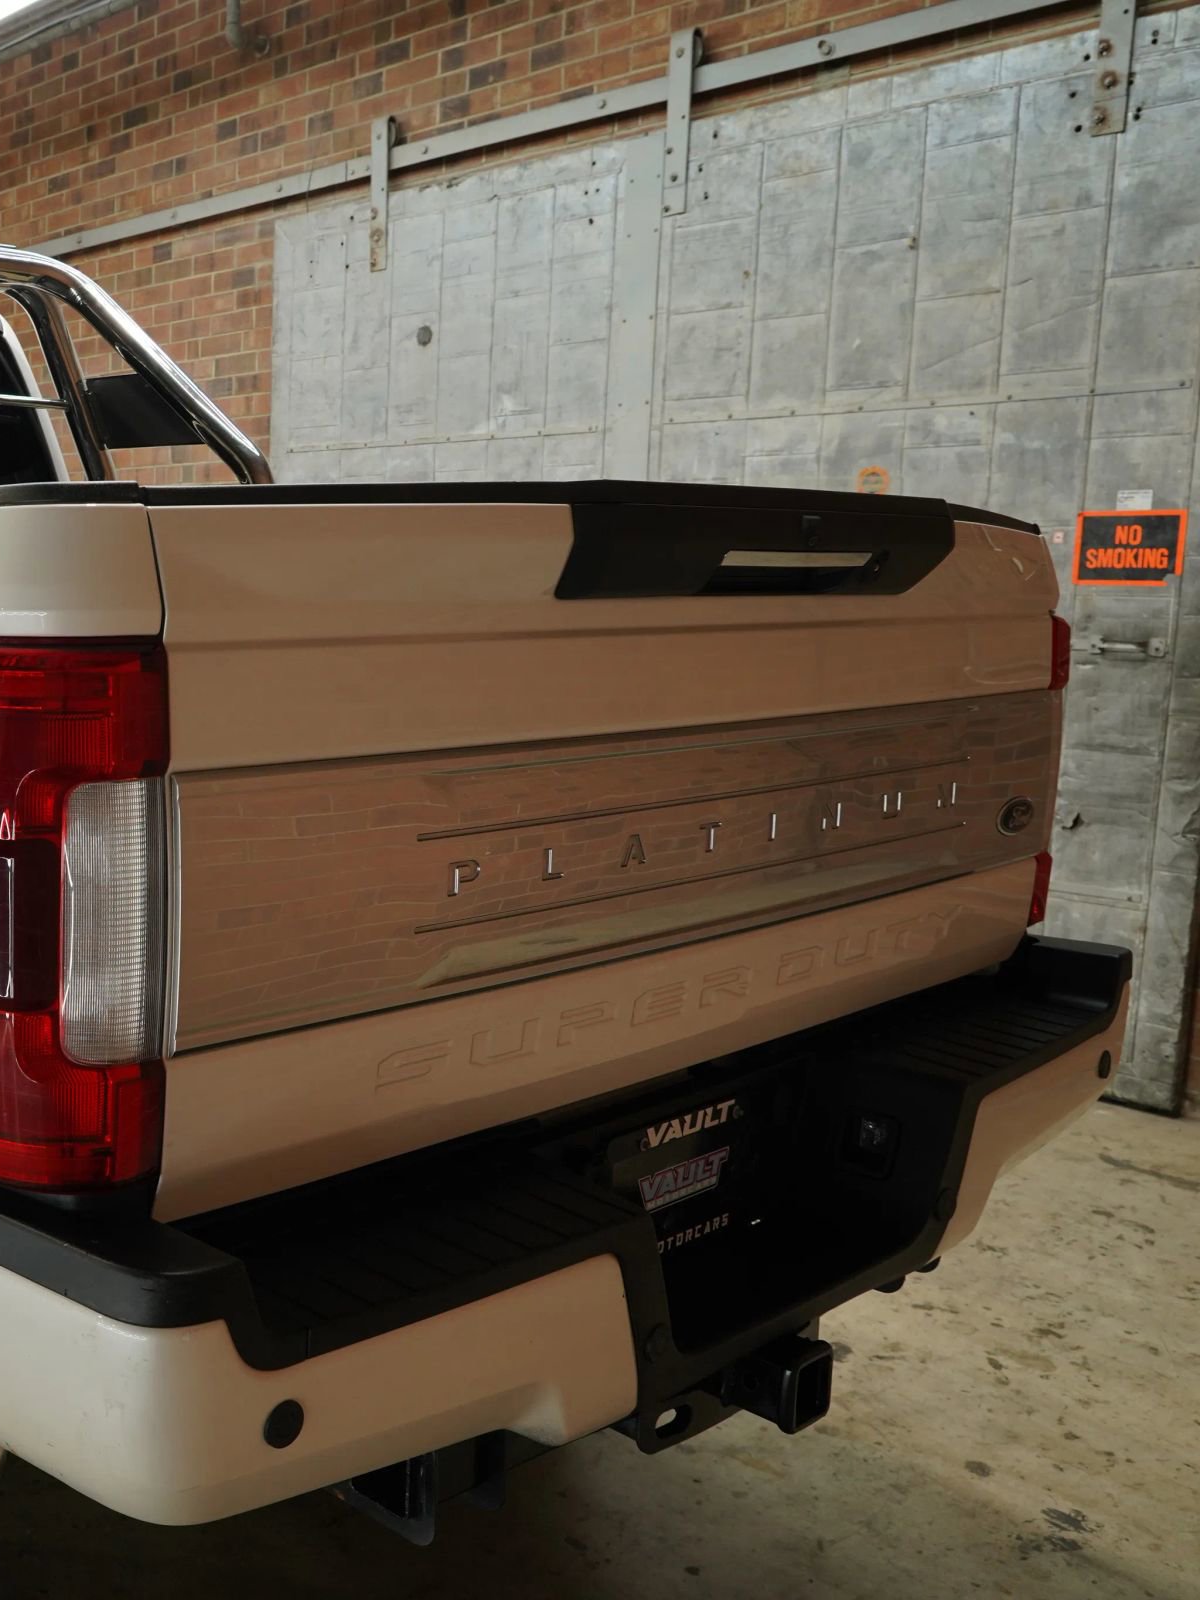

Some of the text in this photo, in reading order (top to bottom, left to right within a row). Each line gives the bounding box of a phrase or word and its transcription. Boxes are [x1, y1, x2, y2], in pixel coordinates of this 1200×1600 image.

[1084, 547, 1170, 570] SMOKING
[1114, 524, 1143, 546] NO
[447, 781, 956, 896] PLATINUM
[375, 904, 965, 1091] SUPER DUTY
[646, 1099, 736, 1148] VAULT
[639, 1147, 730, 1204] VAULT
[657, 1213, 730, 1254] OTORCARS
